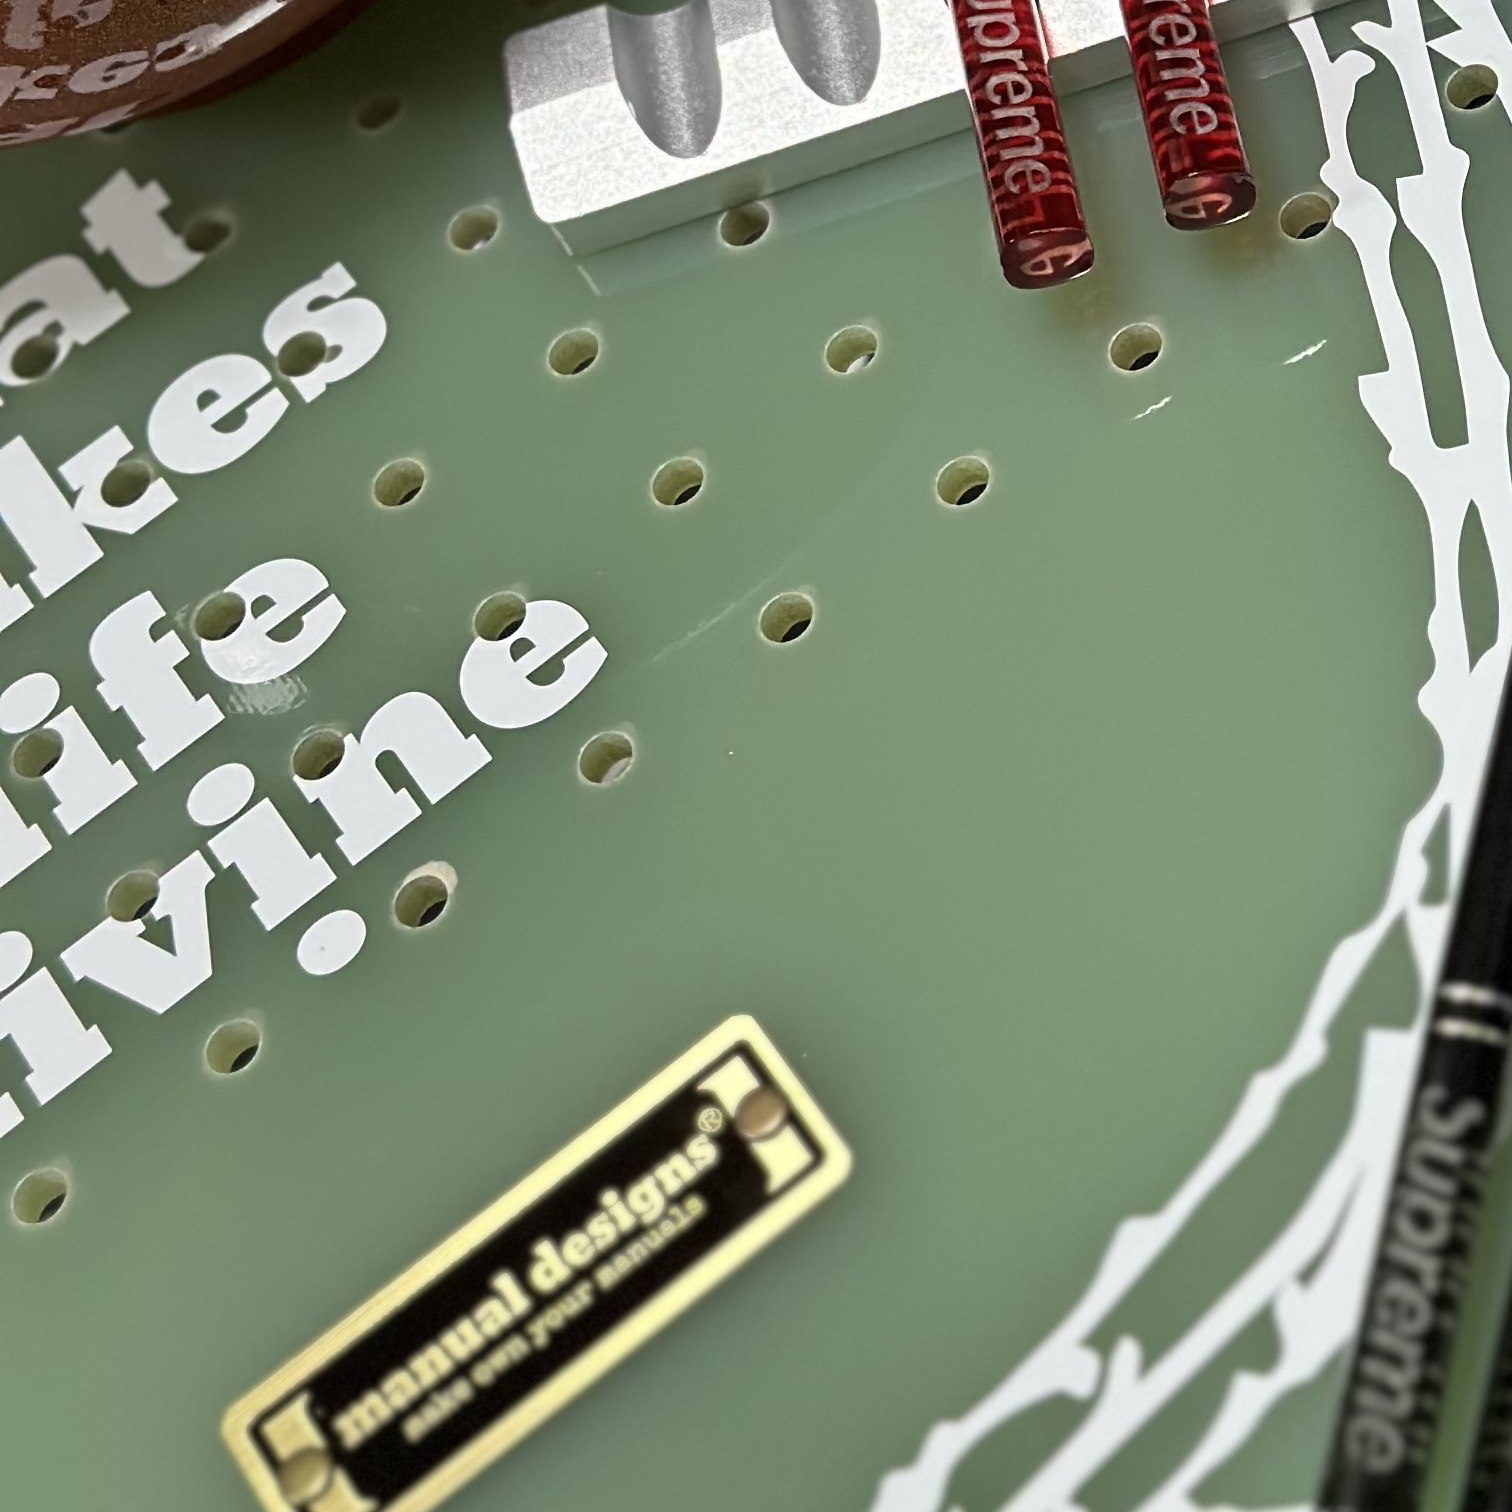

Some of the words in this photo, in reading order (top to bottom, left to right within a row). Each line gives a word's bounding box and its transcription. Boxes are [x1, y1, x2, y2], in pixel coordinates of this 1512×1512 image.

[0, 167, 206, 386] at
[0, 262, 387, 628] kes
[0, 558, 347, 887] ife
[333, 1270, 532, 1449] manual
[471, 1335, 530, 1386] own
[527, 1282, 594, 1349] your
[595, 1195, 706, 1290] manuals
[1346, 1083, 1486, 1476] Supreme
